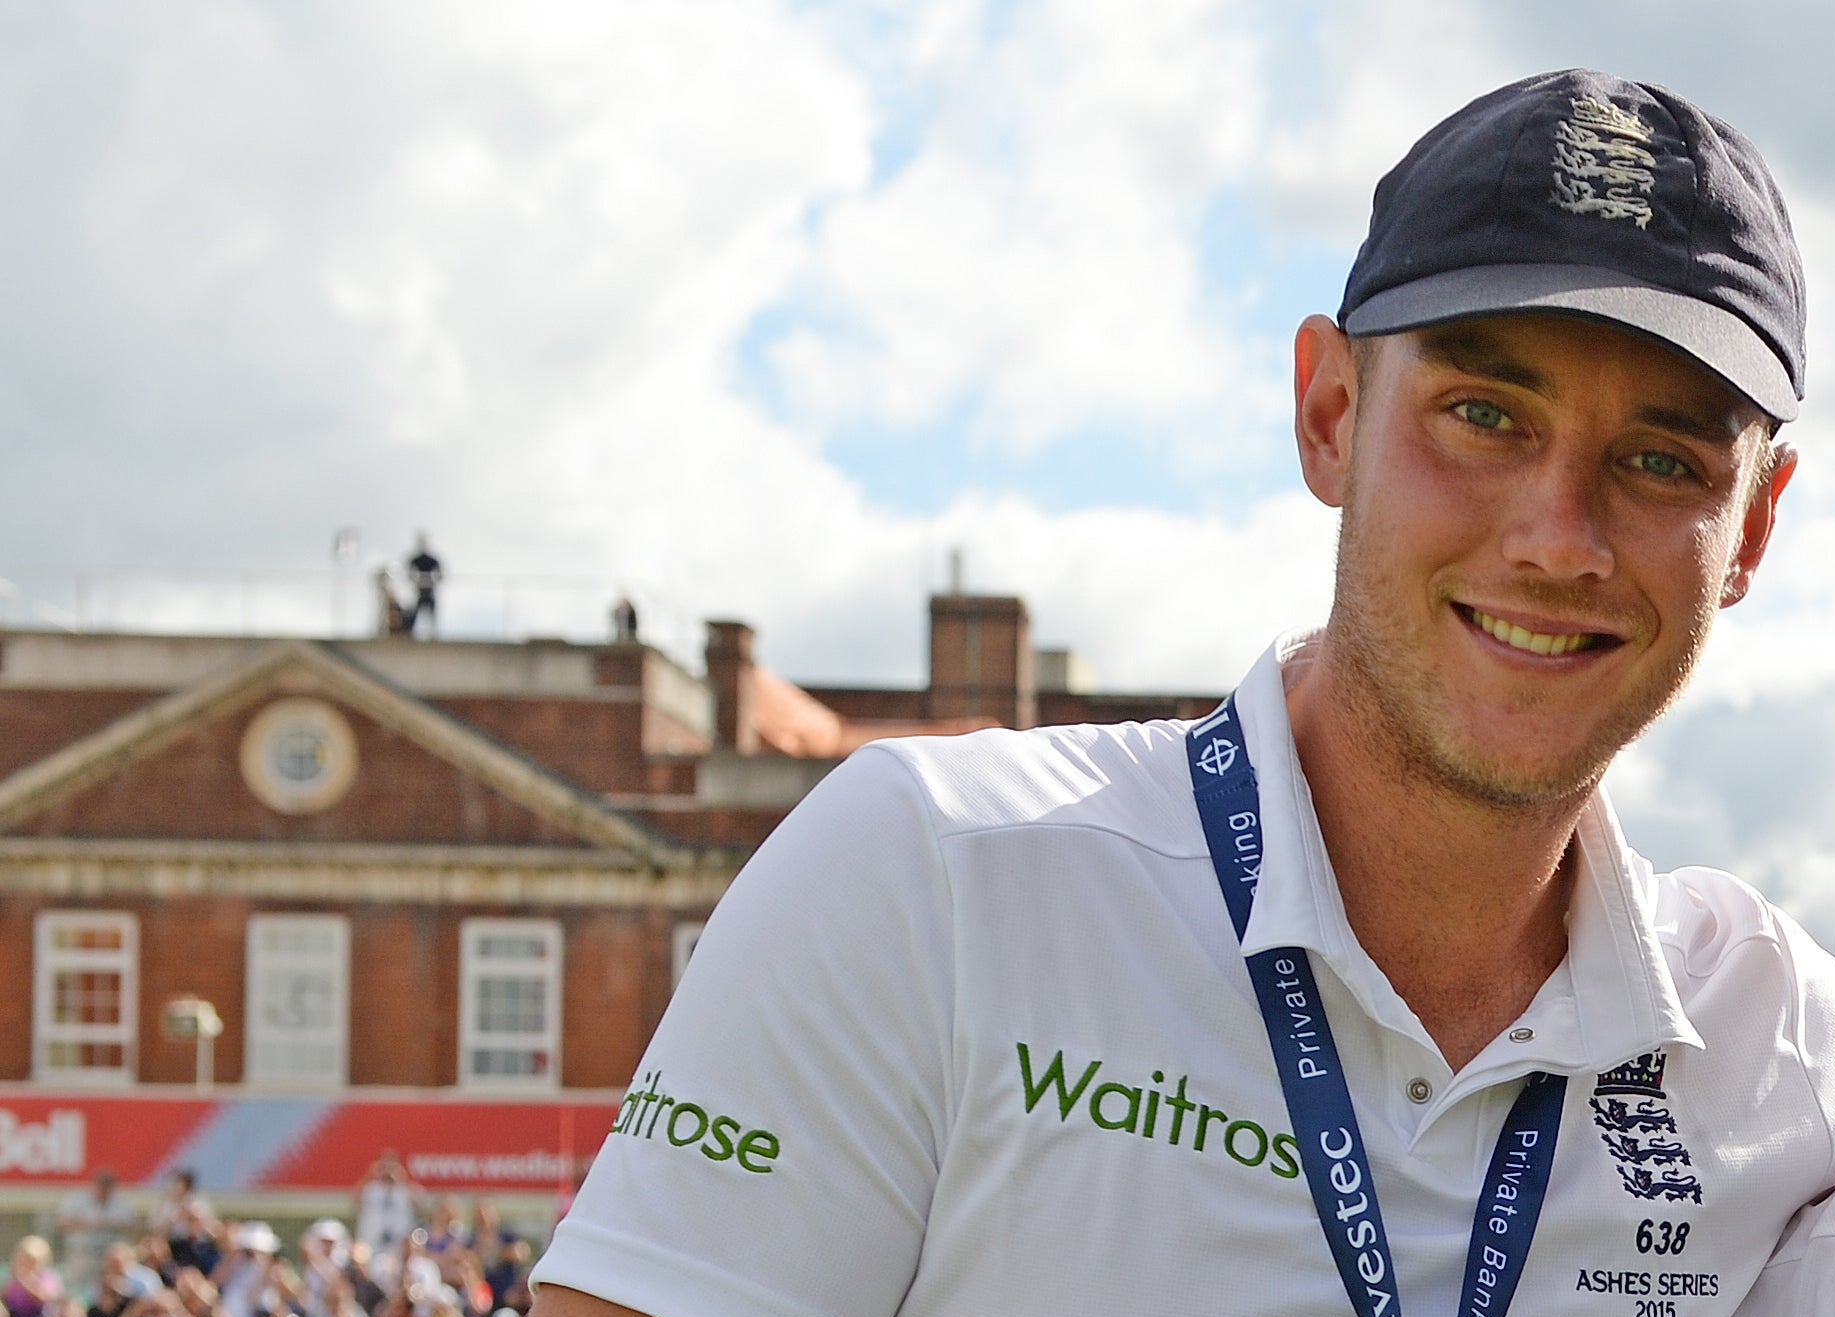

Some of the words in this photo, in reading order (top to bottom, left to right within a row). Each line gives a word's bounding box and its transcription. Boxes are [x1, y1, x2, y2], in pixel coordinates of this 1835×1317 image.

[1275, 957, 1328, 1080] Private
[610, 1070, 780, 1173] aitrose
[1016, 1042, 1301, 1179] Waitros
[1488, 1129, 1539, 1235] Private
[1576, 1269, 1651, 1296] ASHES
[1658, 1272, 1719, 1297] SERIES
[1636, 1219, 1690, 1255] 638
